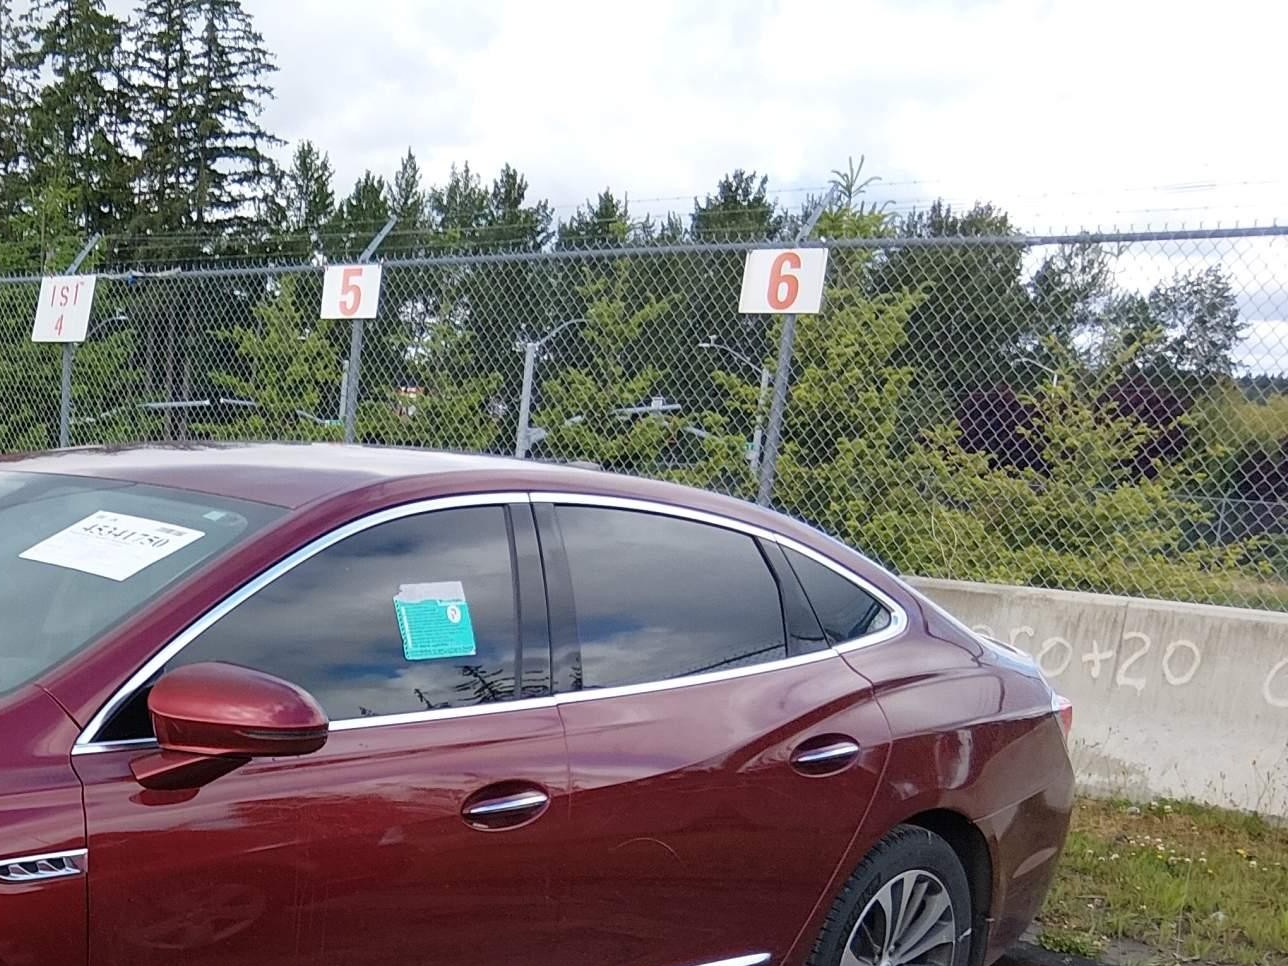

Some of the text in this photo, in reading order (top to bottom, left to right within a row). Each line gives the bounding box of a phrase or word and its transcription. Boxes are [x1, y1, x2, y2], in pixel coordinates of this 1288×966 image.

[338, 267, 364, 316] 5
[765, 251, 801, 310] 6
[54, 314, 64, 336] 4
